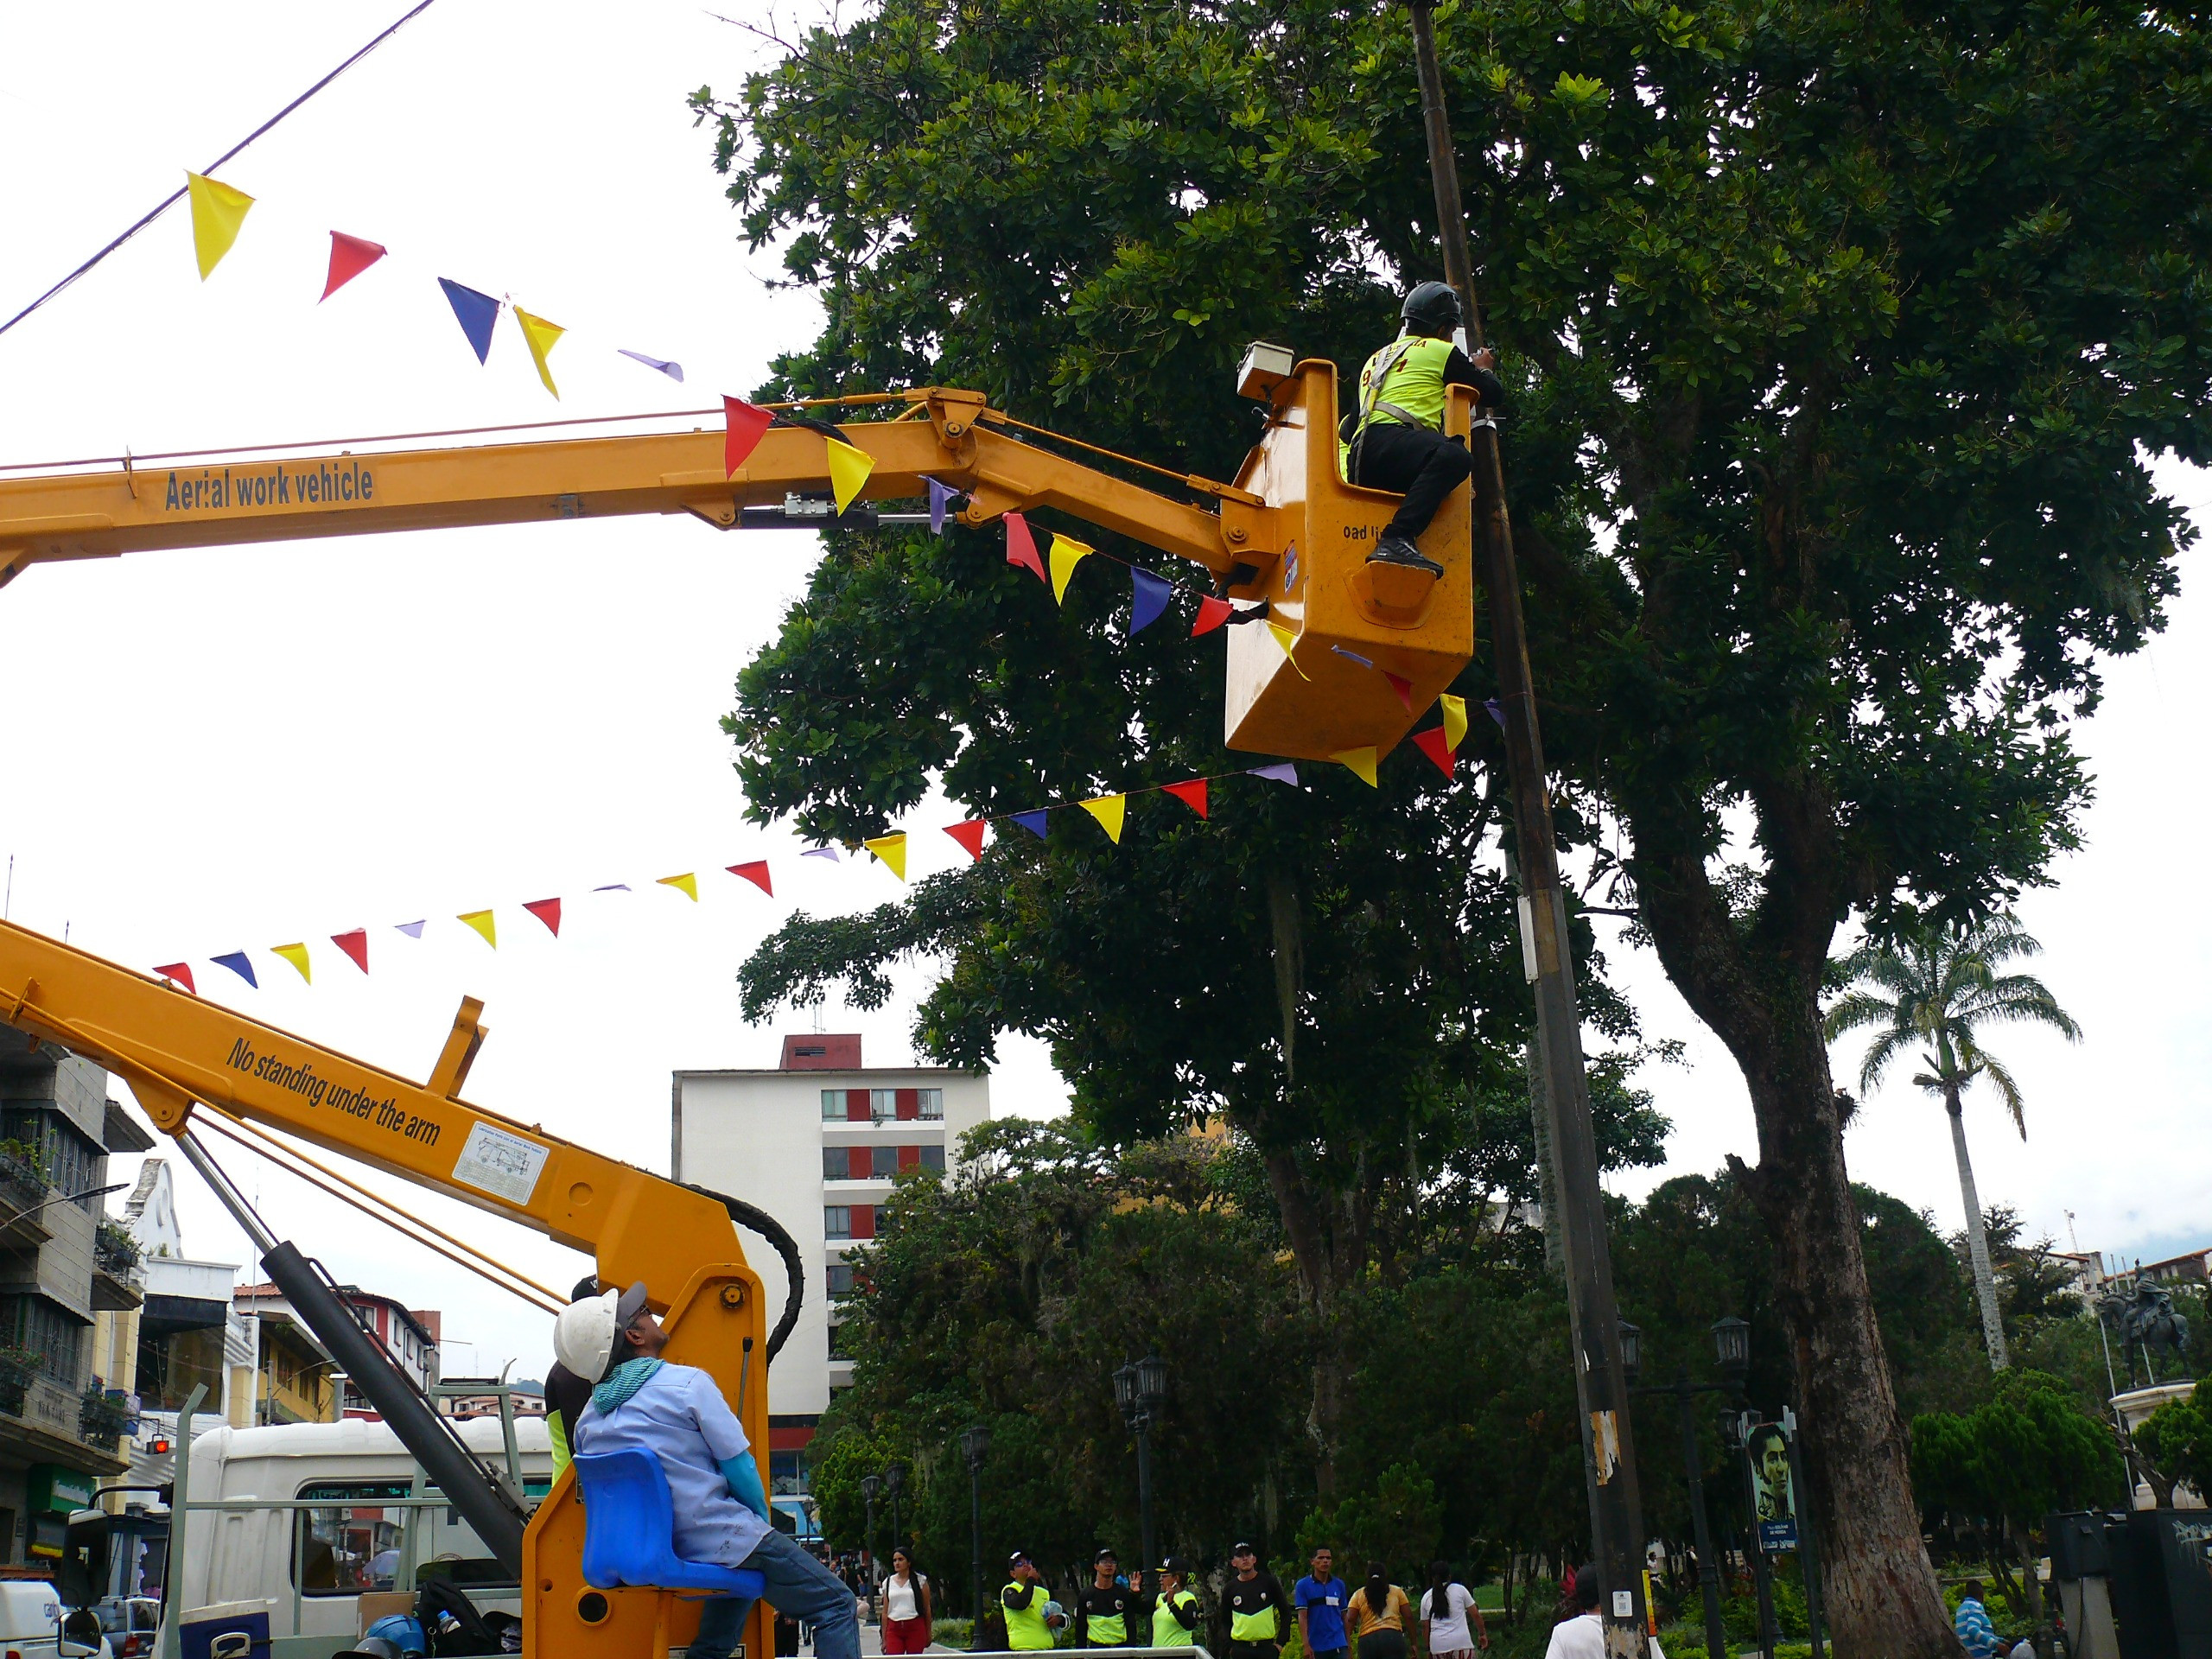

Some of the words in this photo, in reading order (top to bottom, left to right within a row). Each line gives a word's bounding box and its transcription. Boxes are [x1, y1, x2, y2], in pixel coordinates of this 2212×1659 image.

[165, 469, 230, 511] Aerial
[236, 466, 289, 506] work
[295, 461, 372, 503] vehicle
[226, 1037, 255, 1071] No
[253, 1054, 329, 1108] standing
[326, 1086, 378, 1120] under
[376, 1098, 406, 1132] the
[404, 1117, 442, 1147] arm
